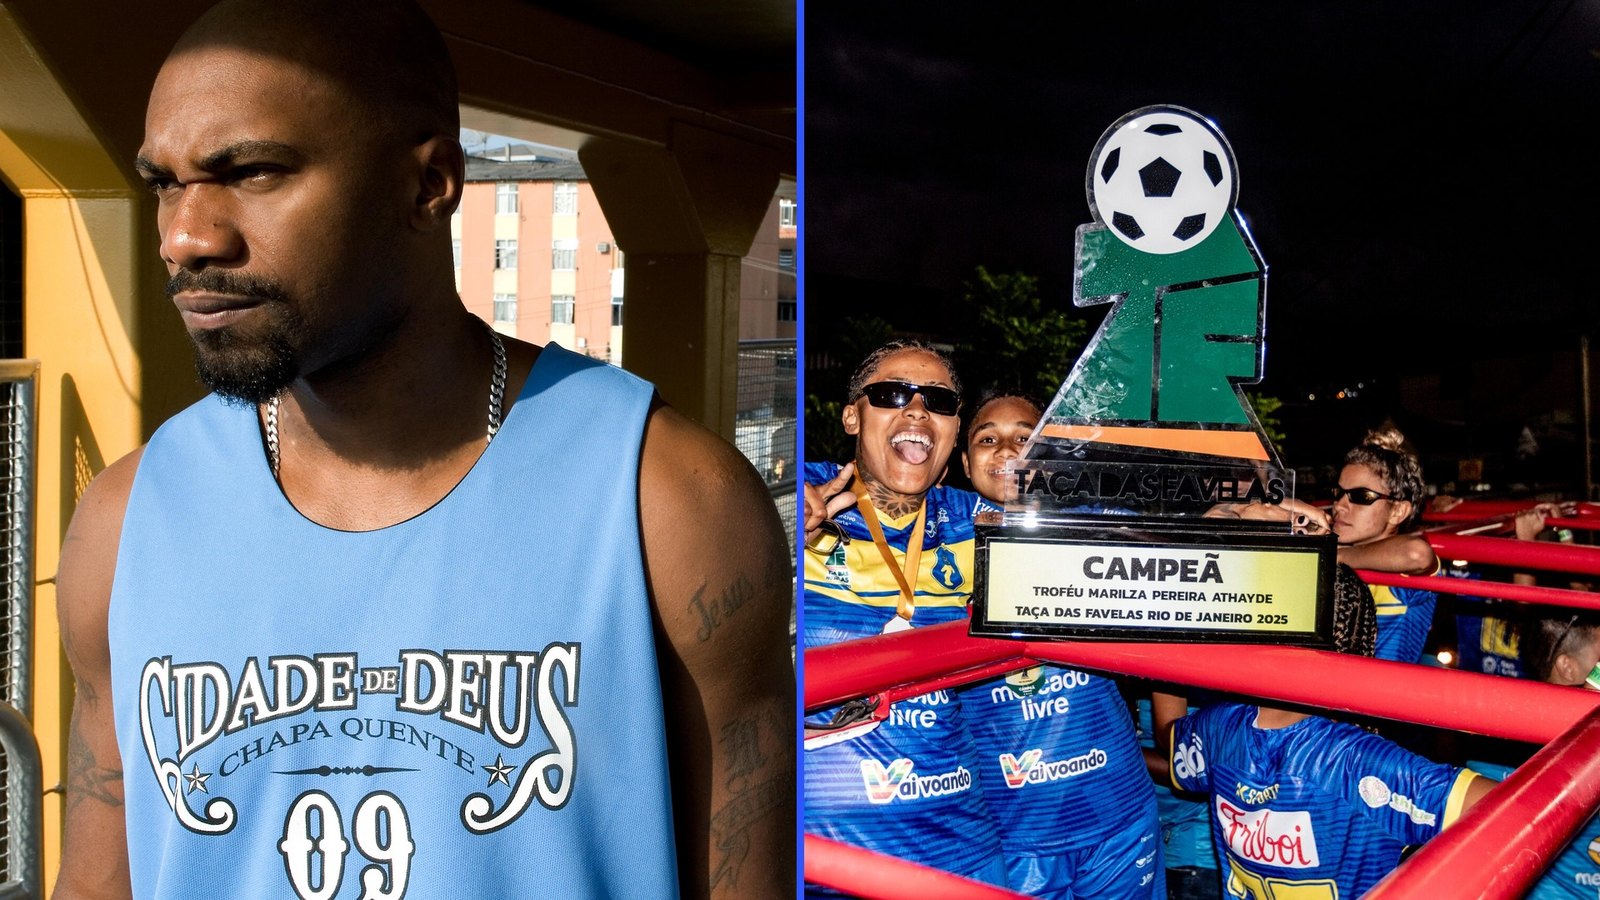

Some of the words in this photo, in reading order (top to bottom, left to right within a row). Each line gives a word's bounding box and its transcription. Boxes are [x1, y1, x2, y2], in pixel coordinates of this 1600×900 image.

[1083, 552, 1223, 584] CAMPEÃ
[1033, 583, 1084, 598] TROFÉU
[1089, 587, 1147, 600] MARILZA
[1152, 589, 1207, 602] PEREIRA
[1212, 591, 1273, 604] ATHAYDE
[1015, 605, 1050, 620] TAÇA
[1054, 606, 1081, 618] DAS
[1085, 607, 1144, 620] FAVELAS
[1147, 609, 1171, 621] RIO
[1174, 610, 1193, 622] DE
[1196, 611, 1253, 624] JANEIRO
[1256, 613, 1288, 625] 2025
[991, 669, 1090, 704] mcado
[1021, 696, 1069, 721] livre
[139, 652, 358, 835] CIDADE
[361, 666, 400, 695] DE
[399, 641, 583, 835] DEUS
[219, 723, 332, 777] CHAPA
[340, 717, 476, 776] QUENTE
[862, 759, 918, 802] Vai
[922, 768, 971, 797] voando
[1001, 750, 1044, 787] Vai
[1049, 752, 1106, 779] voando
[277, 789, 416, 900] 09
[1220, 802, 1311, 866] Friboi
